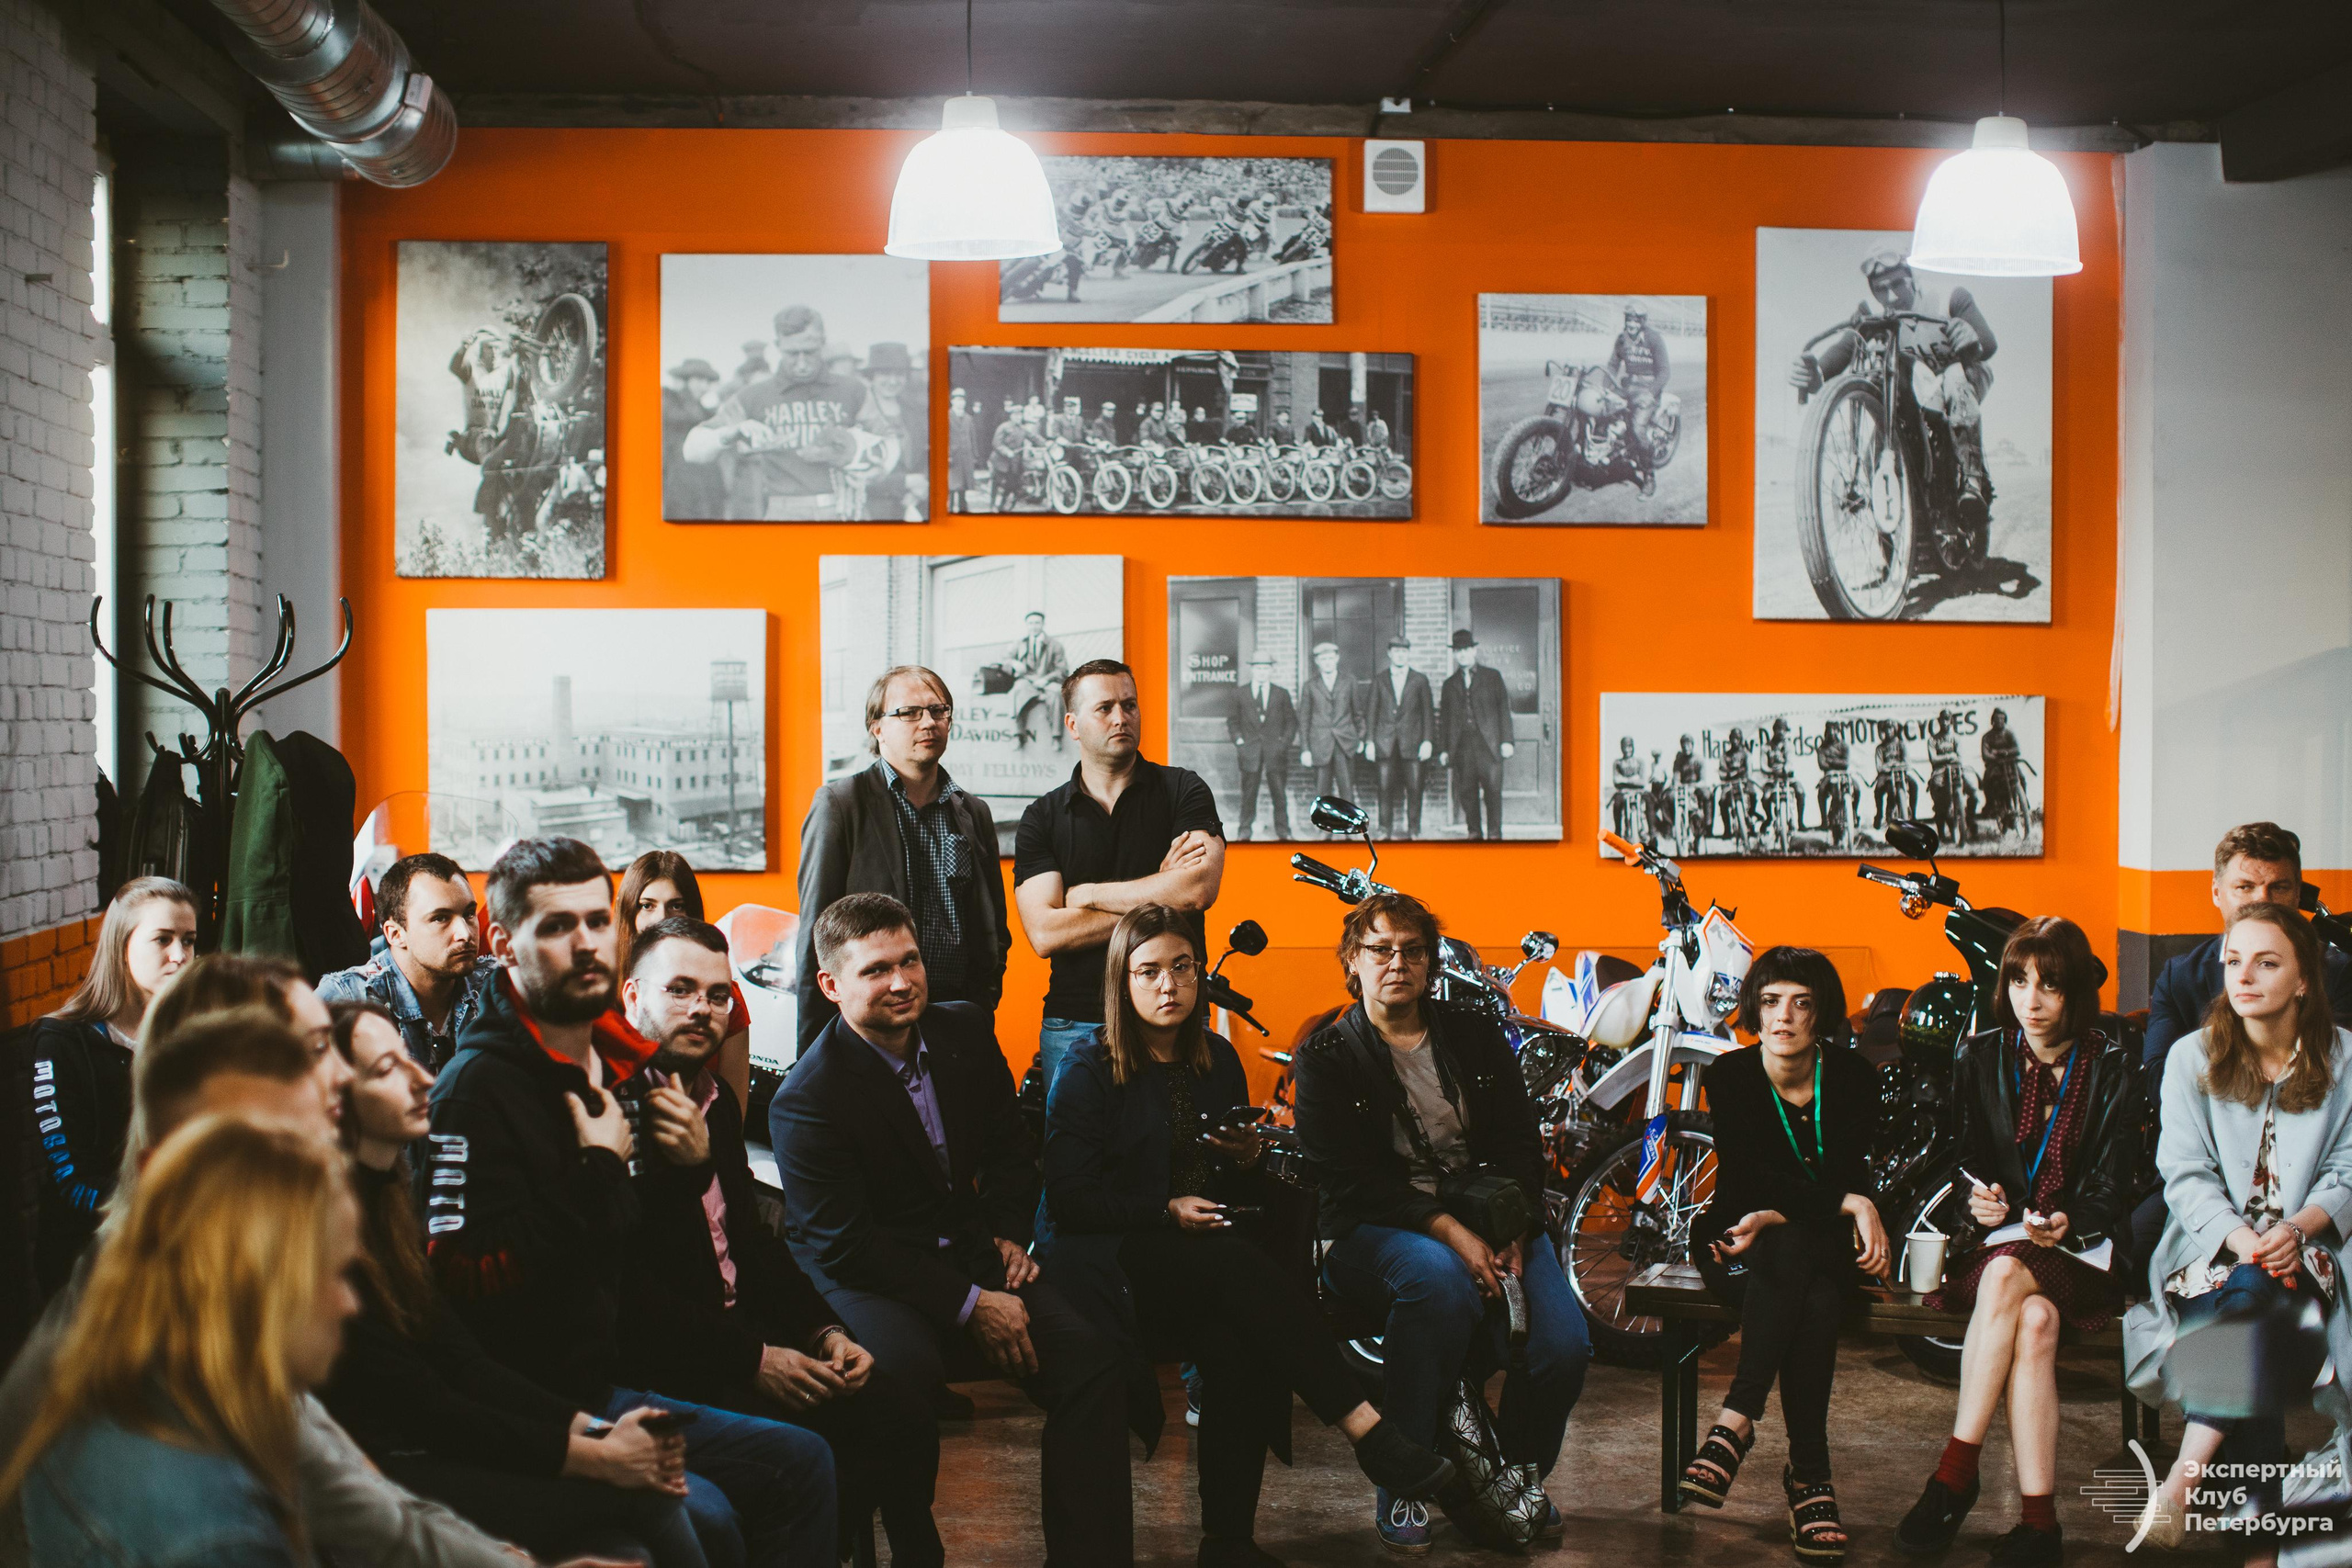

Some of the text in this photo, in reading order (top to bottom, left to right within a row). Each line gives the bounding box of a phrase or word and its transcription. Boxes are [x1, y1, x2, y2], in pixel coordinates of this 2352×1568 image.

[1552, 378, 1571, 400] 20
[1186, 653, 1229, 669] SHOP
[950, 724, 1037, 743] DAVIDSN
[983, 761, 1057, 779] FELLOWS
[749, 1054, 780, 1066] ONDA
